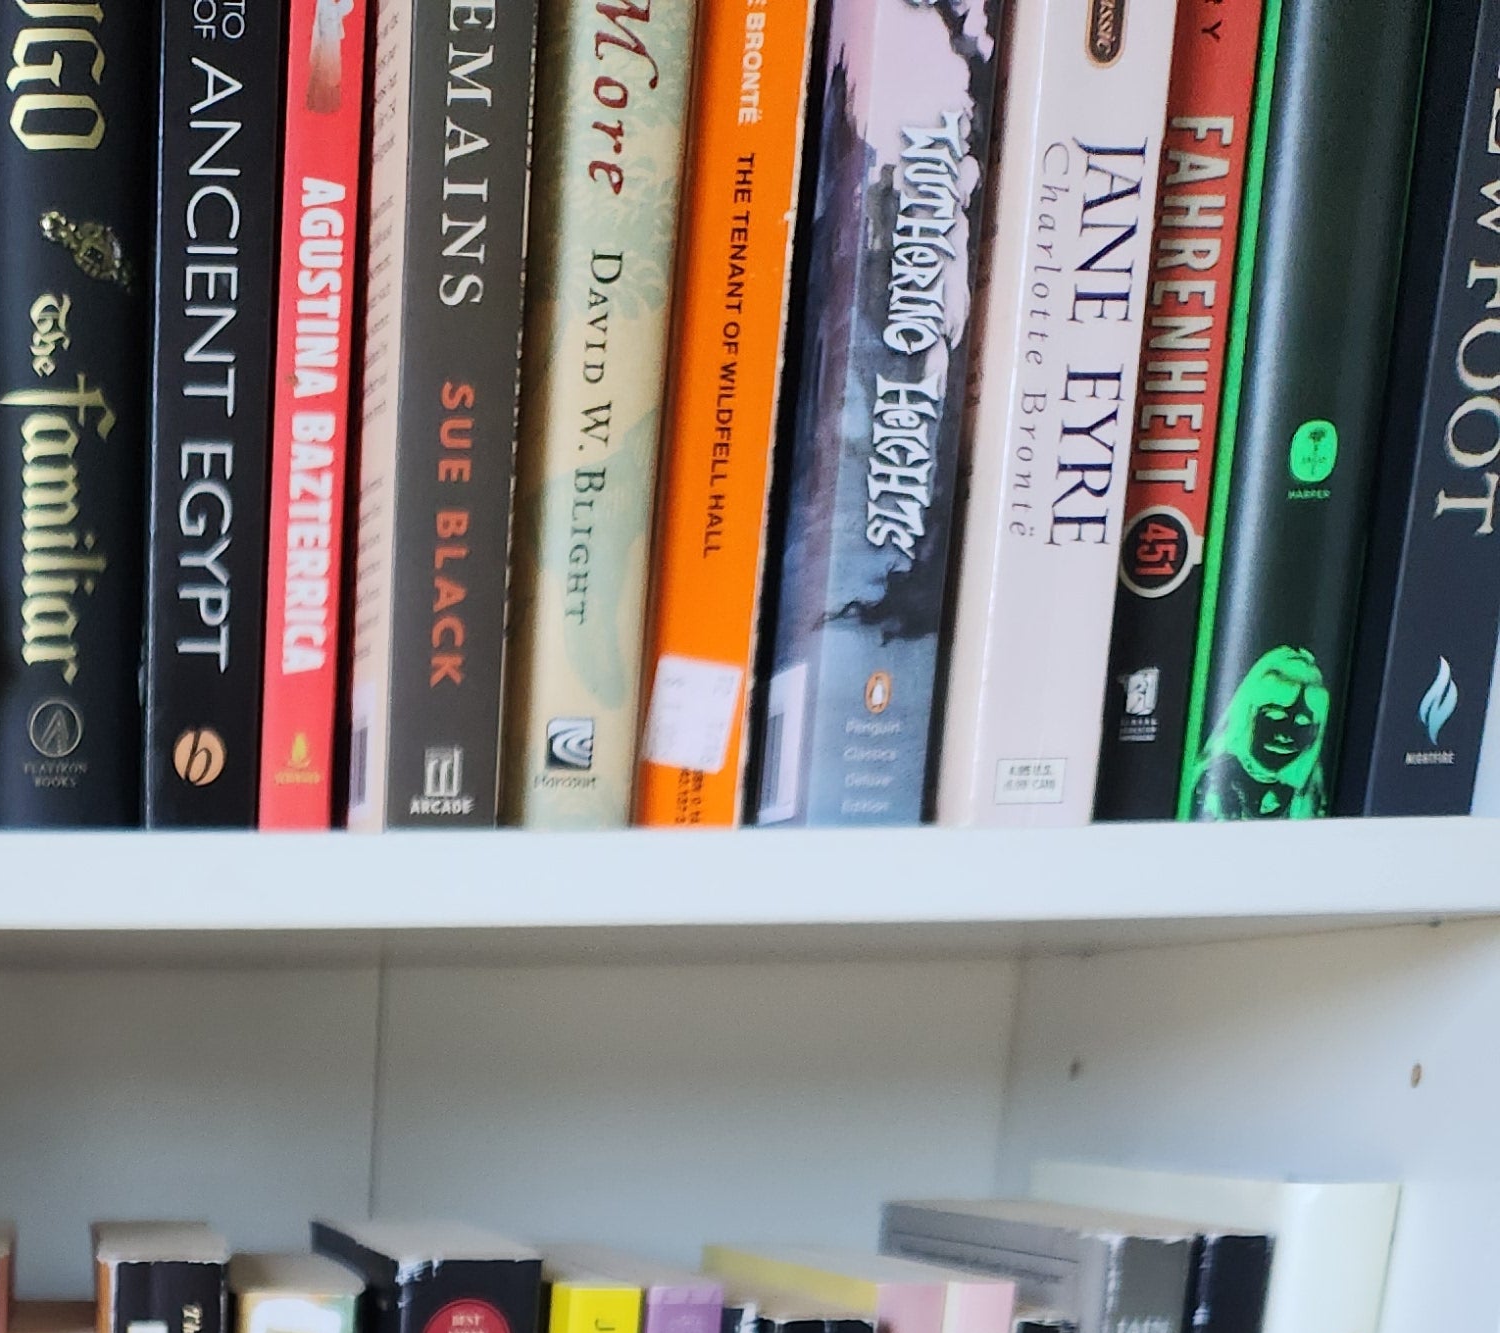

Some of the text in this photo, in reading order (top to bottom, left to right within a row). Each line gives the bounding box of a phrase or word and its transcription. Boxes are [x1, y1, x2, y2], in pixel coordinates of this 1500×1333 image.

[222, 0, 246, 39] TO
[29, 293, 70, 377] The
[172, 0, 244, 674] OF ANCIENT EGYPT
[282, 176, 347, 675] AGUSTINA BAZTERRICA
[563, 249, 623, 626] DAVID W. BLIGHT
[702, 152, 757, 560] THE TENANT OF WILDFELL HALL
[1009, 140, 1071, 541] Charlotte Brontë
[1043, 135, 1149, 548] JANE EYRE
[1132, 114, 1235, 493] FAHRENHEIT
[429, 380, 476, 689] SUE BLACK
[1132, 521, 1177, 578] 451
[409, 799, 476, 815] ARCADE
[451, 1312, 483, 1327] BEST
